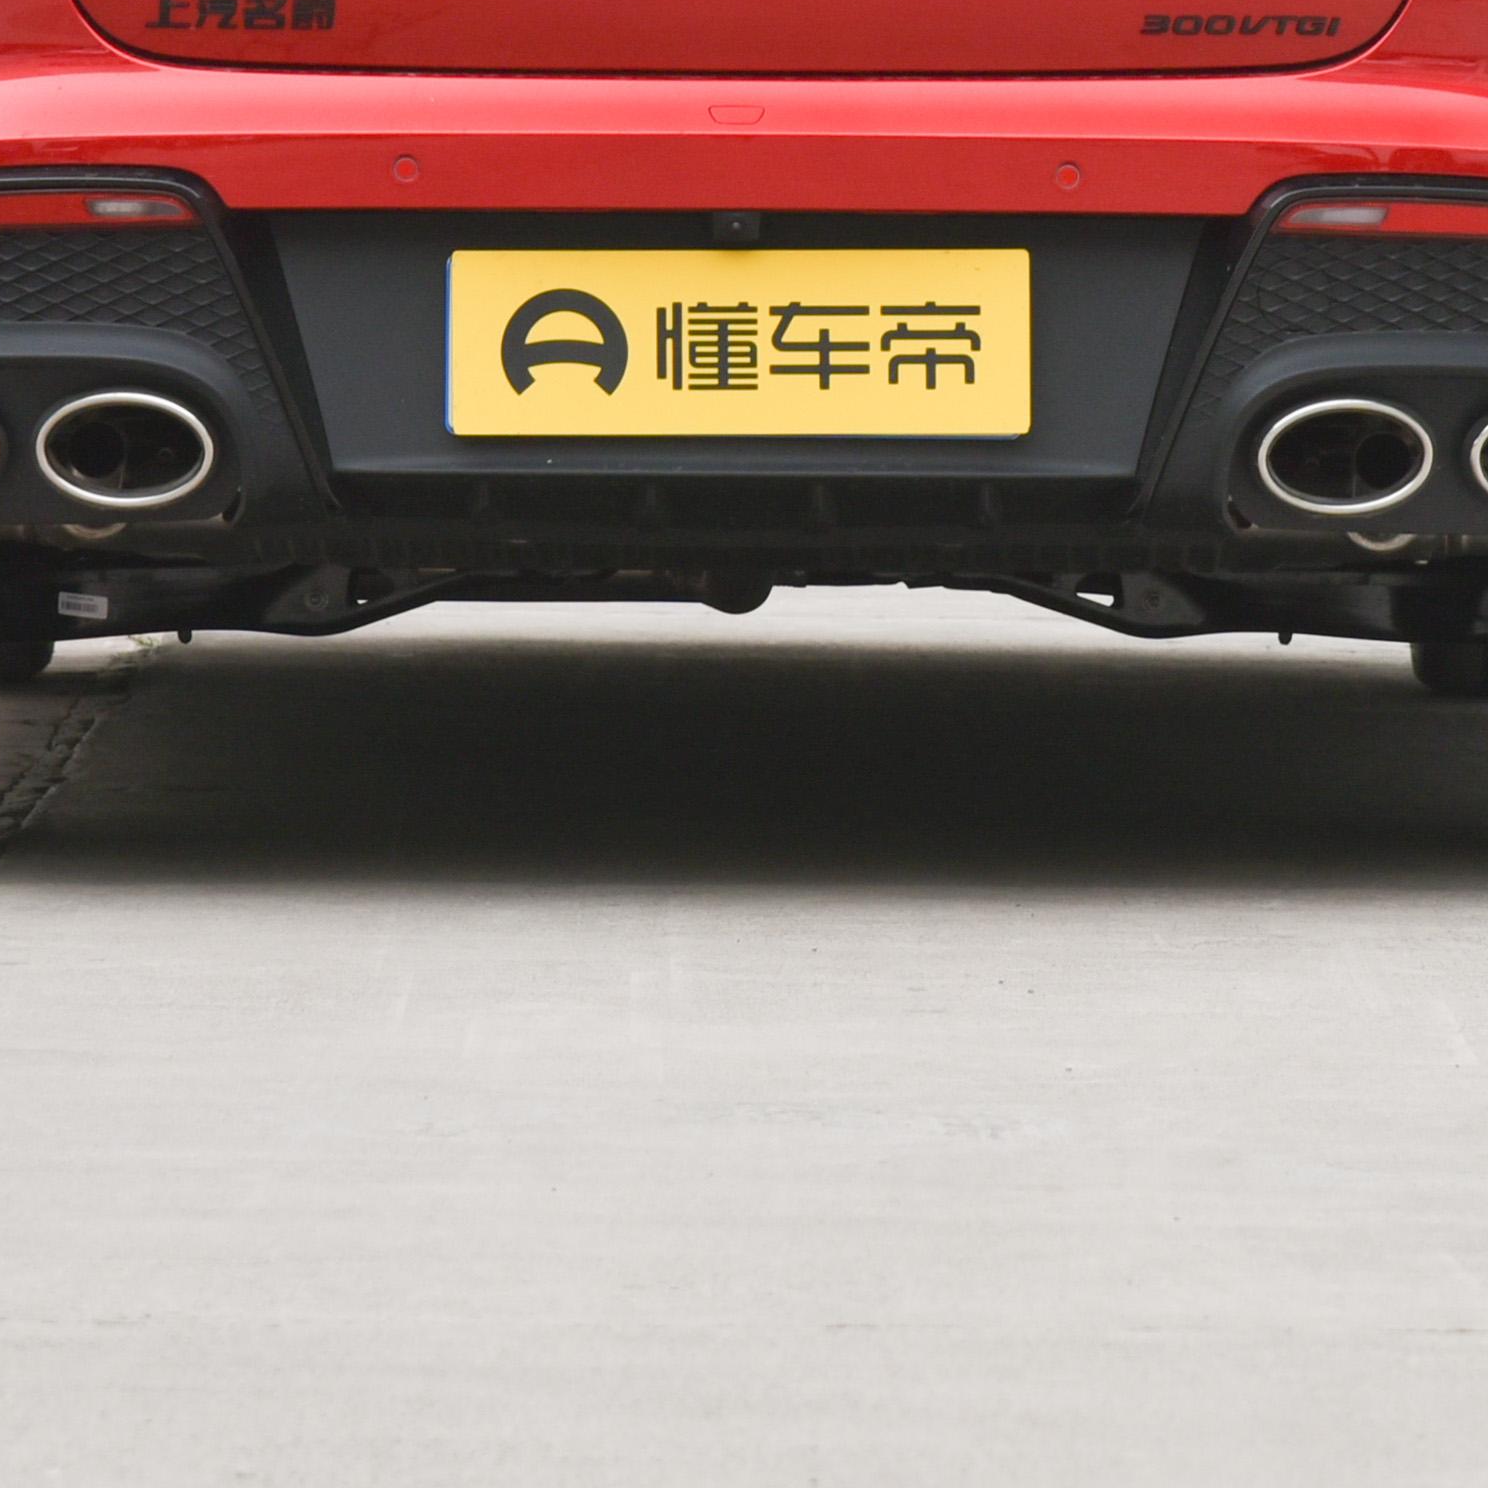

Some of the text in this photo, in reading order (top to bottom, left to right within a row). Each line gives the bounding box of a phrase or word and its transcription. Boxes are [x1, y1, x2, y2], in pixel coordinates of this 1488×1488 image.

[1140, 14, 1341, 37] 300VTGI
[655, 301, 982, 391] 懂车帝
